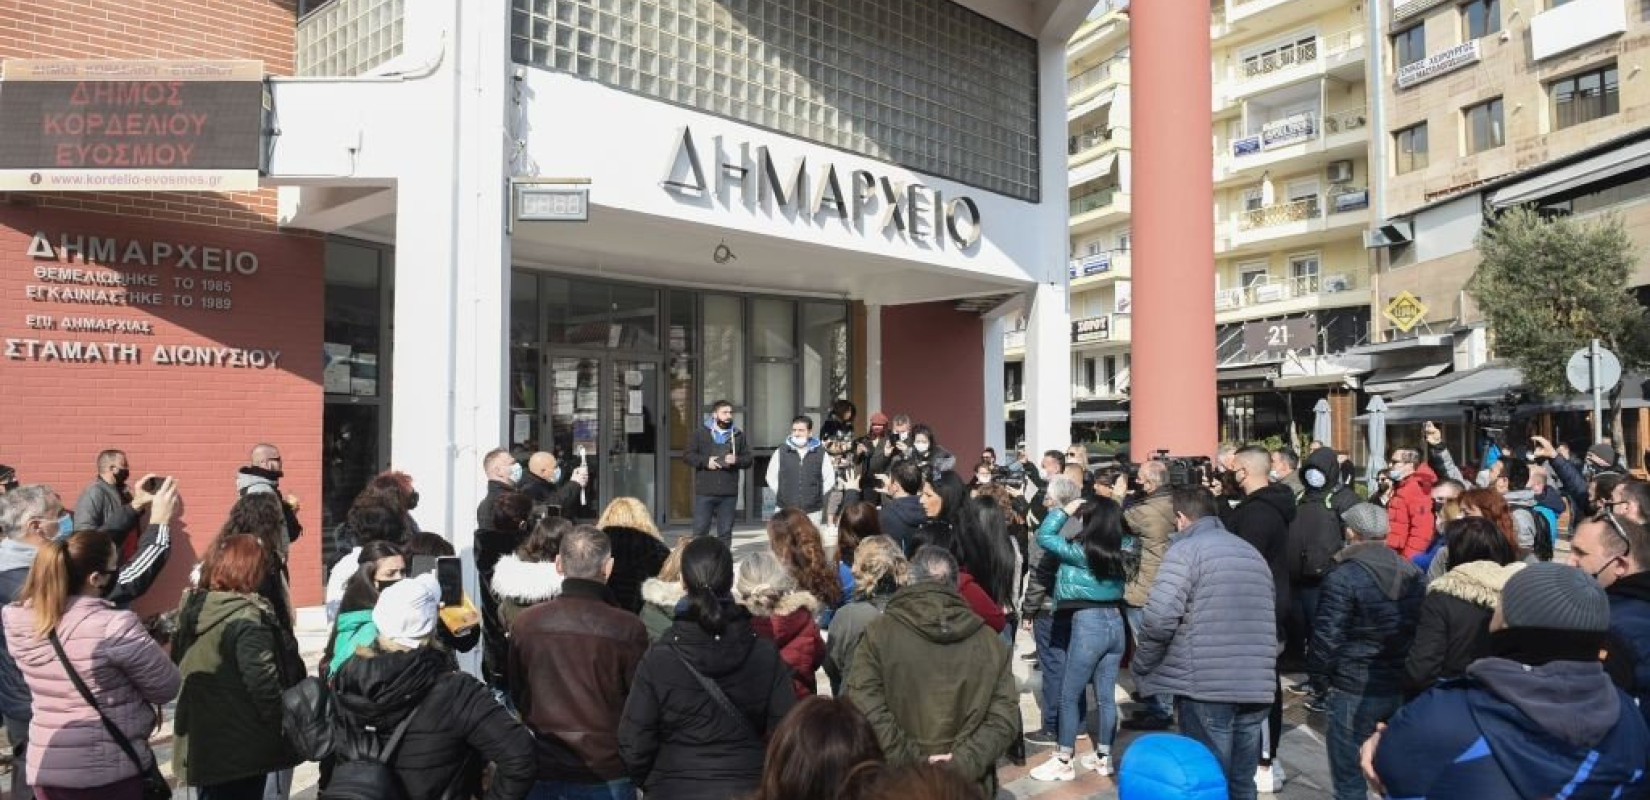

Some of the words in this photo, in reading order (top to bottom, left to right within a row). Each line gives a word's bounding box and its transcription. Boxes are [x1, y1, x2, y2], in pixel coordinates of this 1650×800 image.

[70, 82, 183, 105] ΔΗΜΟΣ
[44, 113, 207, 135] ΚΟΡΔΕΛΙΟΥ
[57, 145, 193, 166] ΕΥΟΣΜΟΥ
[51, 172, 222, 187] www.kordelio-evosmos.gr
[660, 125, 981, 249] ΔΗΜΑΡΧΕΙΟ
[26, 231, 259, 274] ΔΗΜΑΡΧΕΙΟ
[34, 266, 158, 286] ΘΕΜΕΛΙΩΘΗΚΕ
[174, 277, 194, 289] ΤΟ
[203, 279, 232, 292] 1985
[26, 285, 163, 305] ΕΓΚΑΙΝΙΑΣΤΗΚΕ
[173, 294, 193, 306] ΤΟ
[203, 296, 232, 309] 1989
[26, 315, 51, 327] ΕΠΙ
[61, 316, 151, 332] ΔΗΜΑΡΧΙΑΣ
[1268, 325, 1288, 345] 21
[5, 338, 138, 362] ΣΤΑΜΑΤΗ
[153, 346, 281, 367] ΔΙΟΝΥΣΙΟΥ
